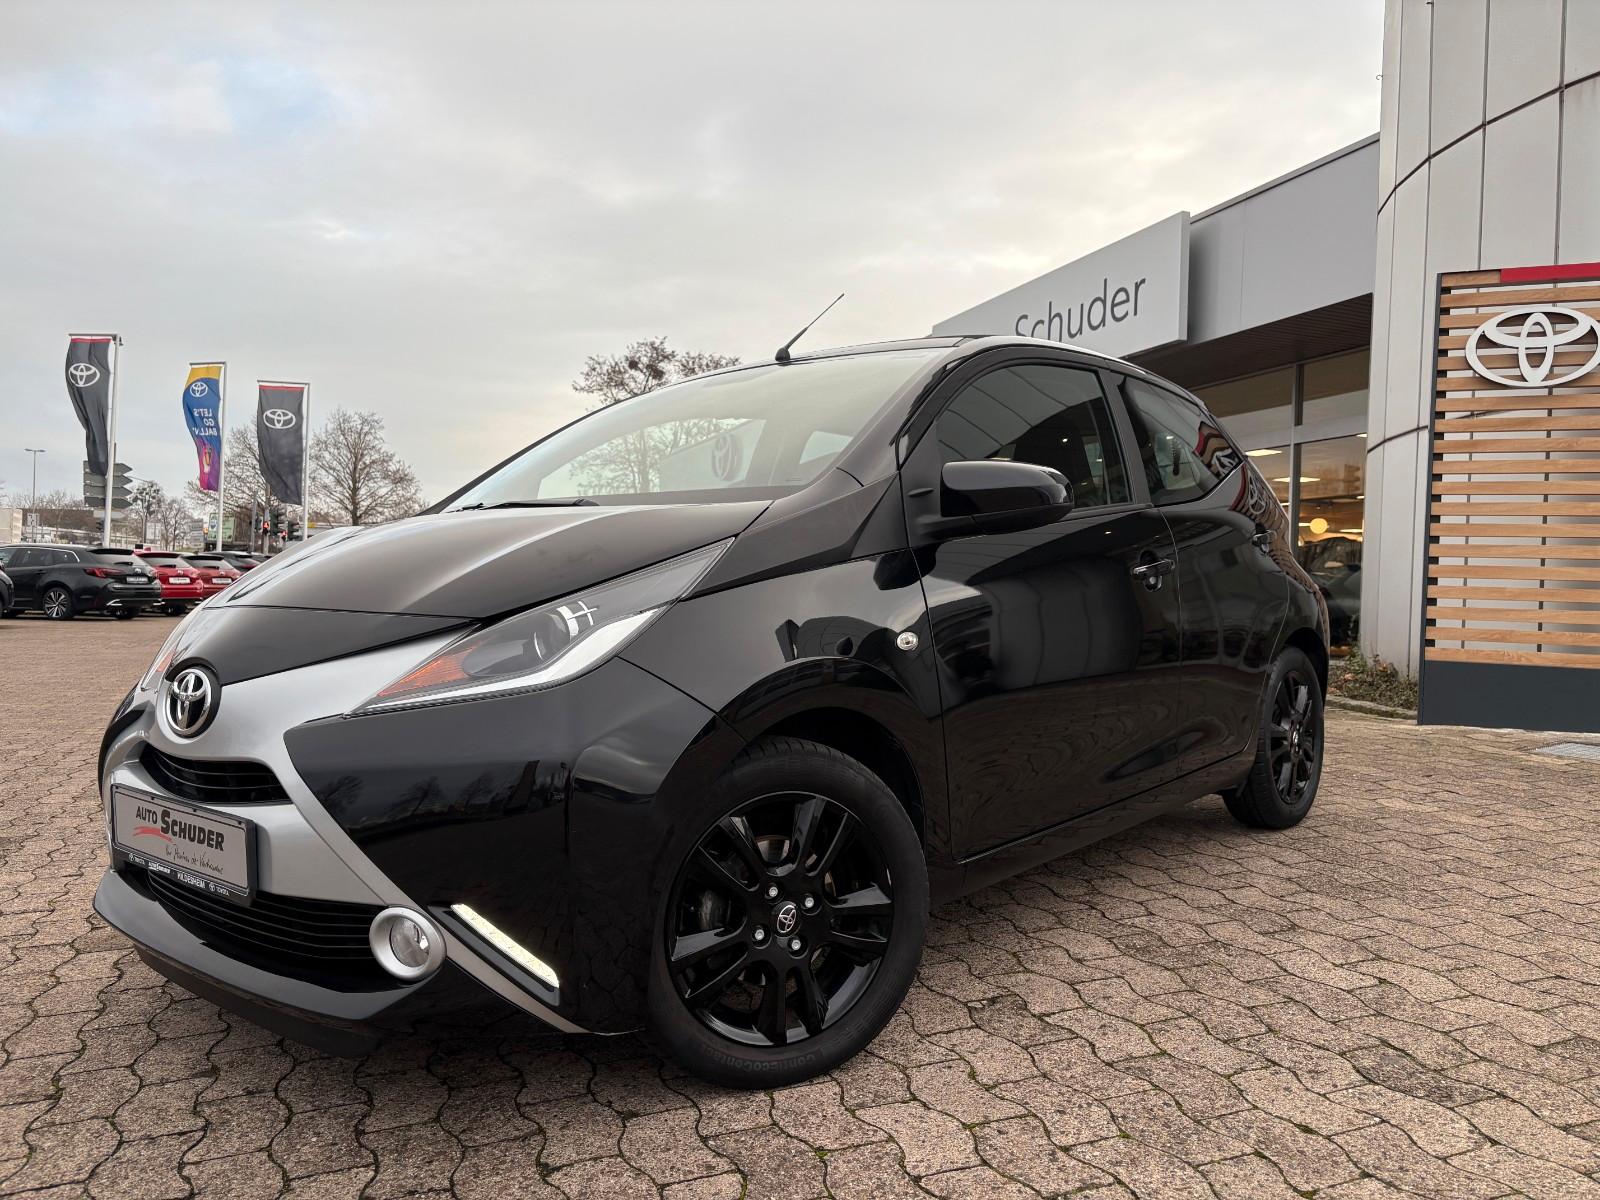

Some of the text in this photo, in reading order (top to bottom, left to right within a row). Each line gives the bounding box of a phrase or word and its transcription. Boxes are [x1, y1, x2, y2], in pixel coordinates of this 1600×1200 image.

[1015, 278, 1146, 343] Schuder
[136, 806, 224, 851] AUTO SCHUDER
